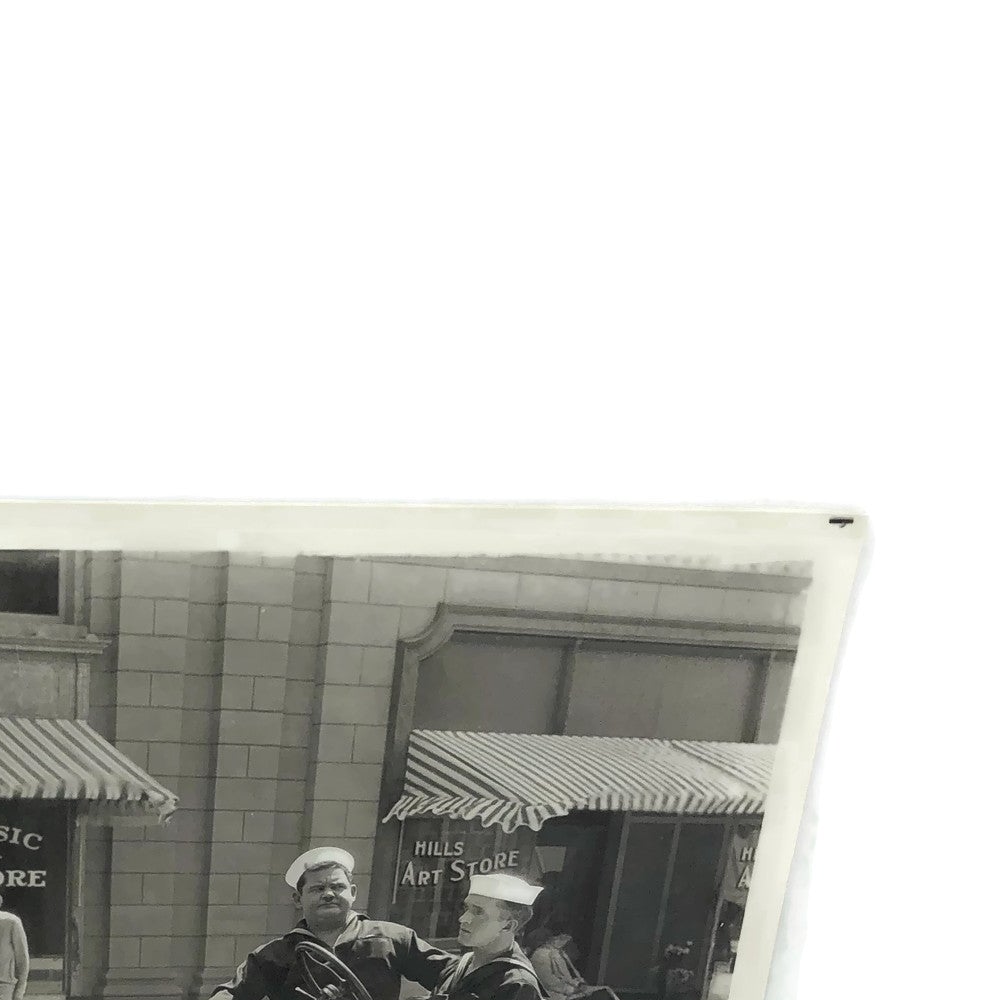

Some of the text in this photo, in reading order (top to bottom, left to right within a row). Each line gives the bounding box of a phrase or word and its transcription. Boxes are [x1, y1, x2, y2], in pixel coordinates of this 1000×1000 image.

[415, 841, 464, 856] HILLS
[401, 850, 520, 886] ART STORE
